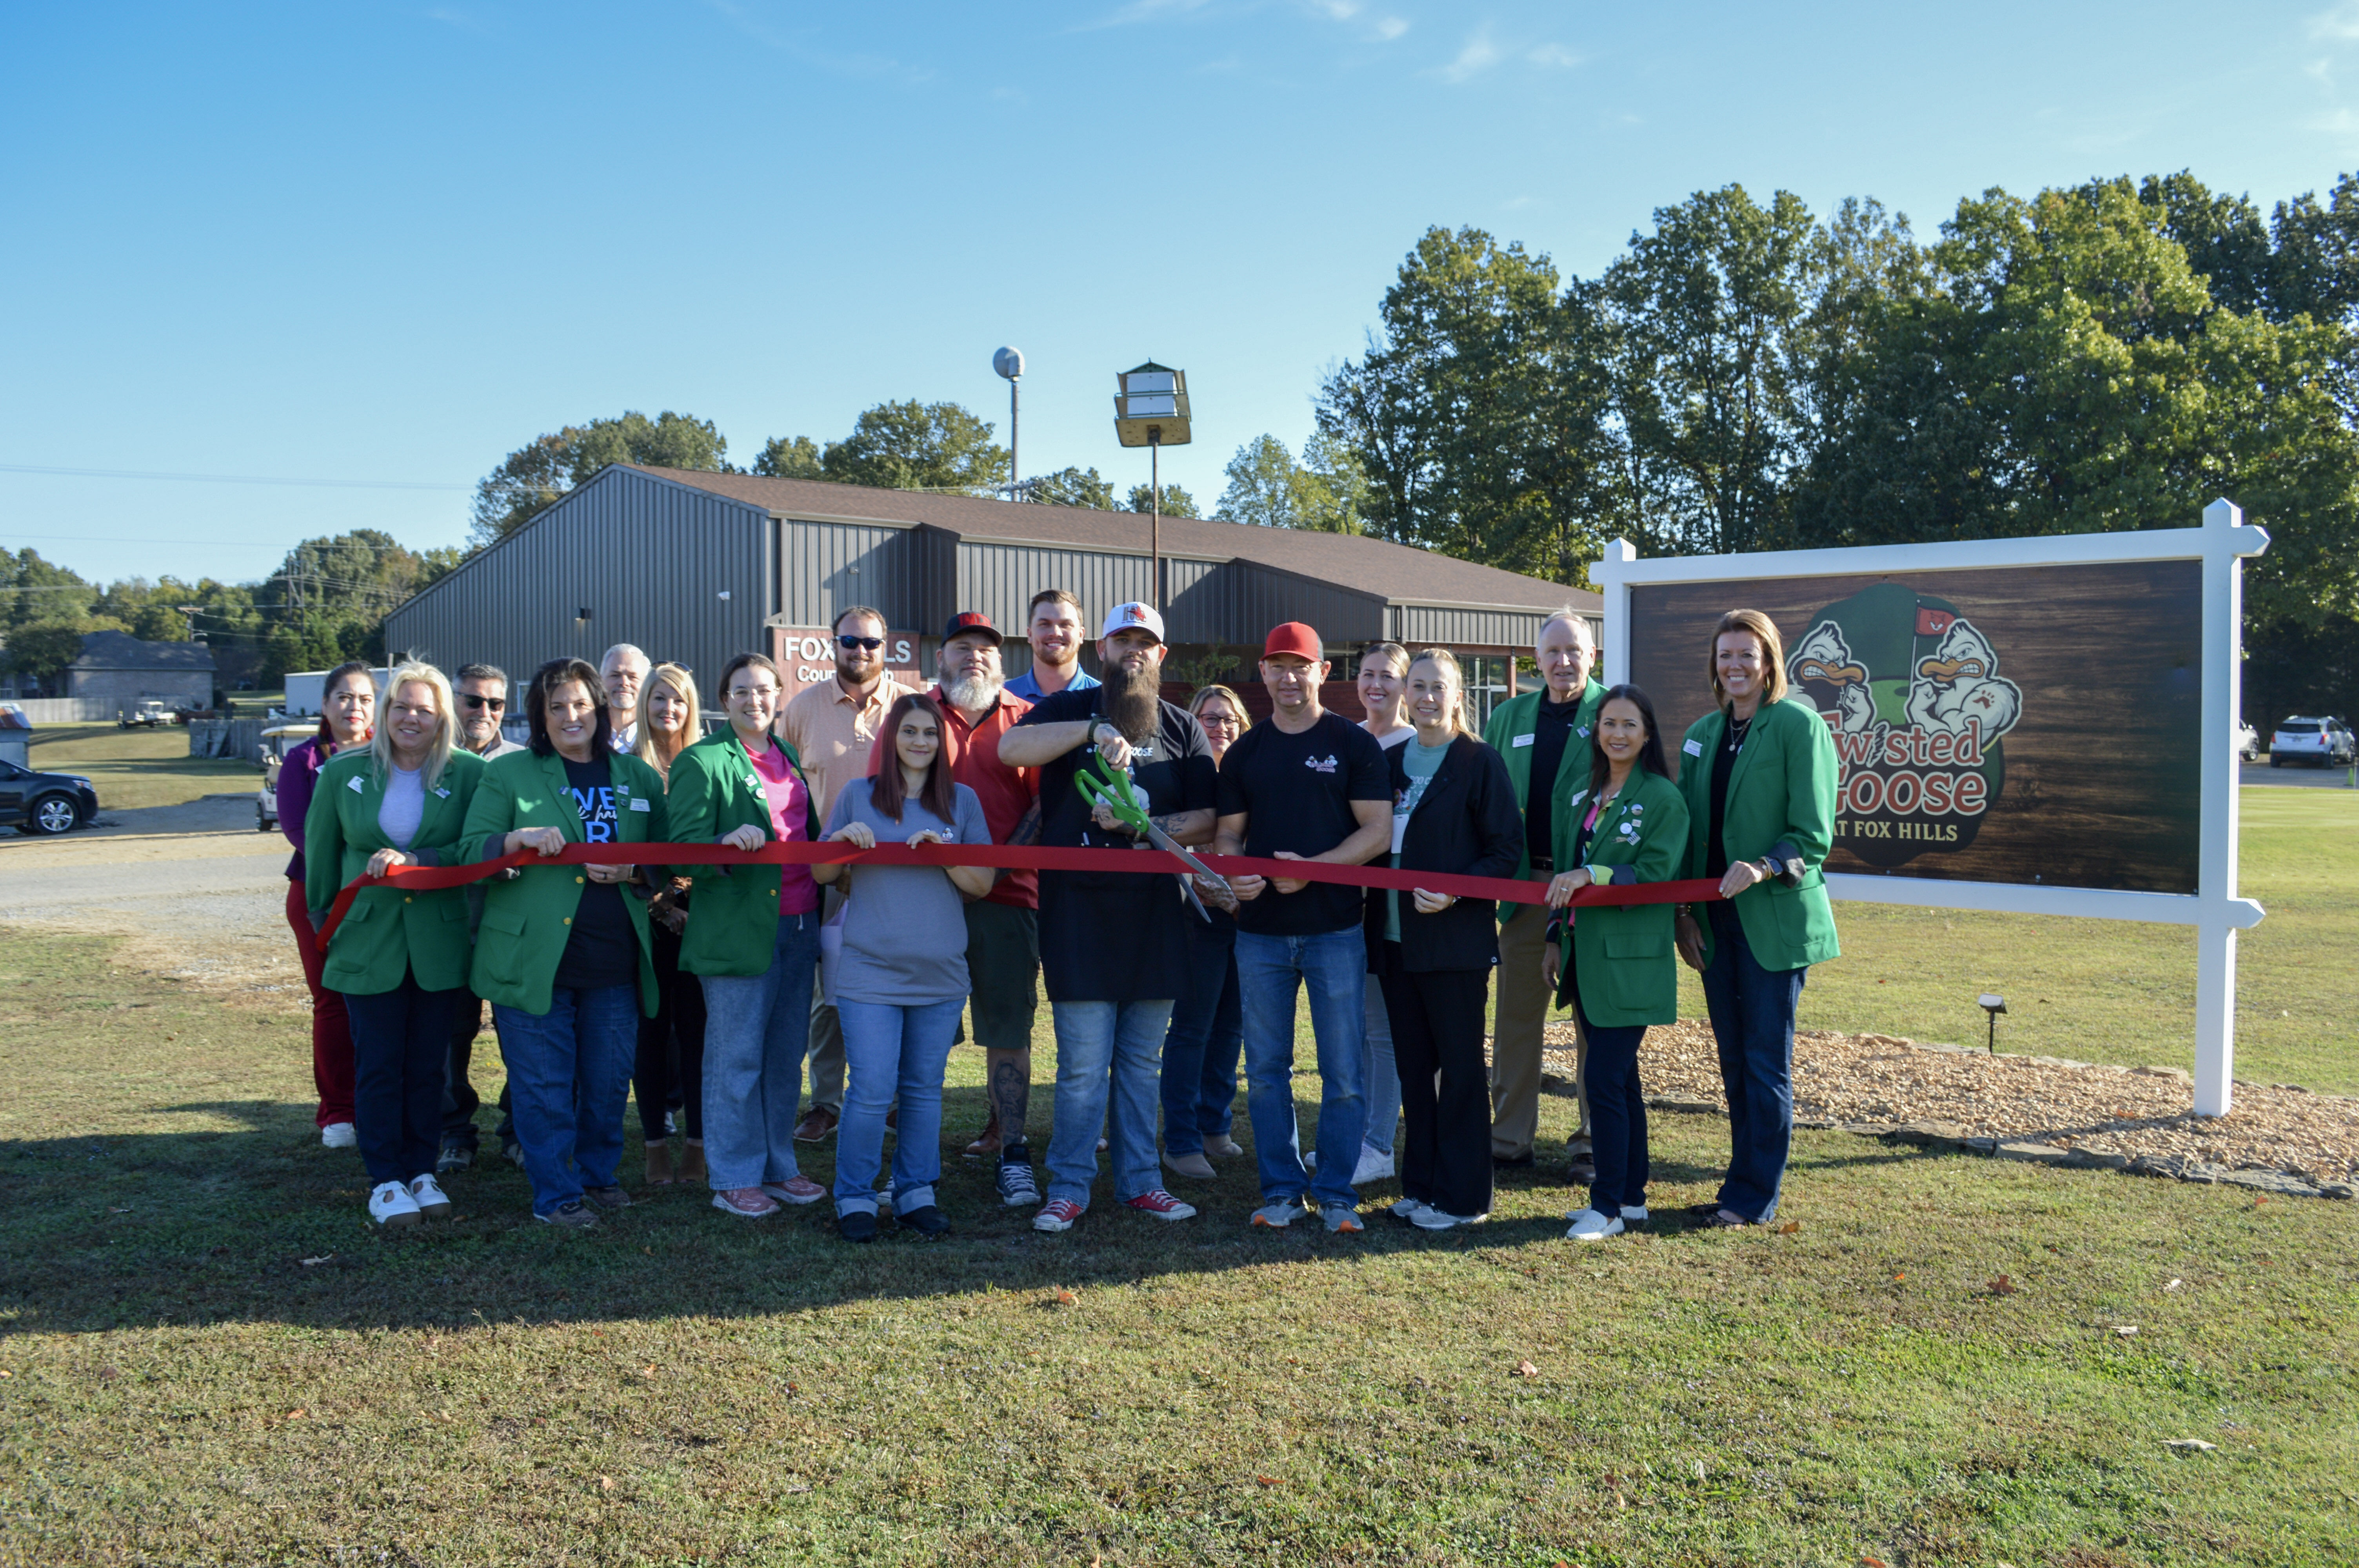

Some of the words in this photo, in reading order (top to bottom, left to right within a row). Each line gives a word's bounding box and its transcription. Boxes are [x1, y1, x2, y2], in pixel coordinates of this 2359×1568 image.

[784, 637, 836, 661] FOX
[1854, 821, 1892, 838] FOX
[1899, 823, 1958, 842] HILLS
